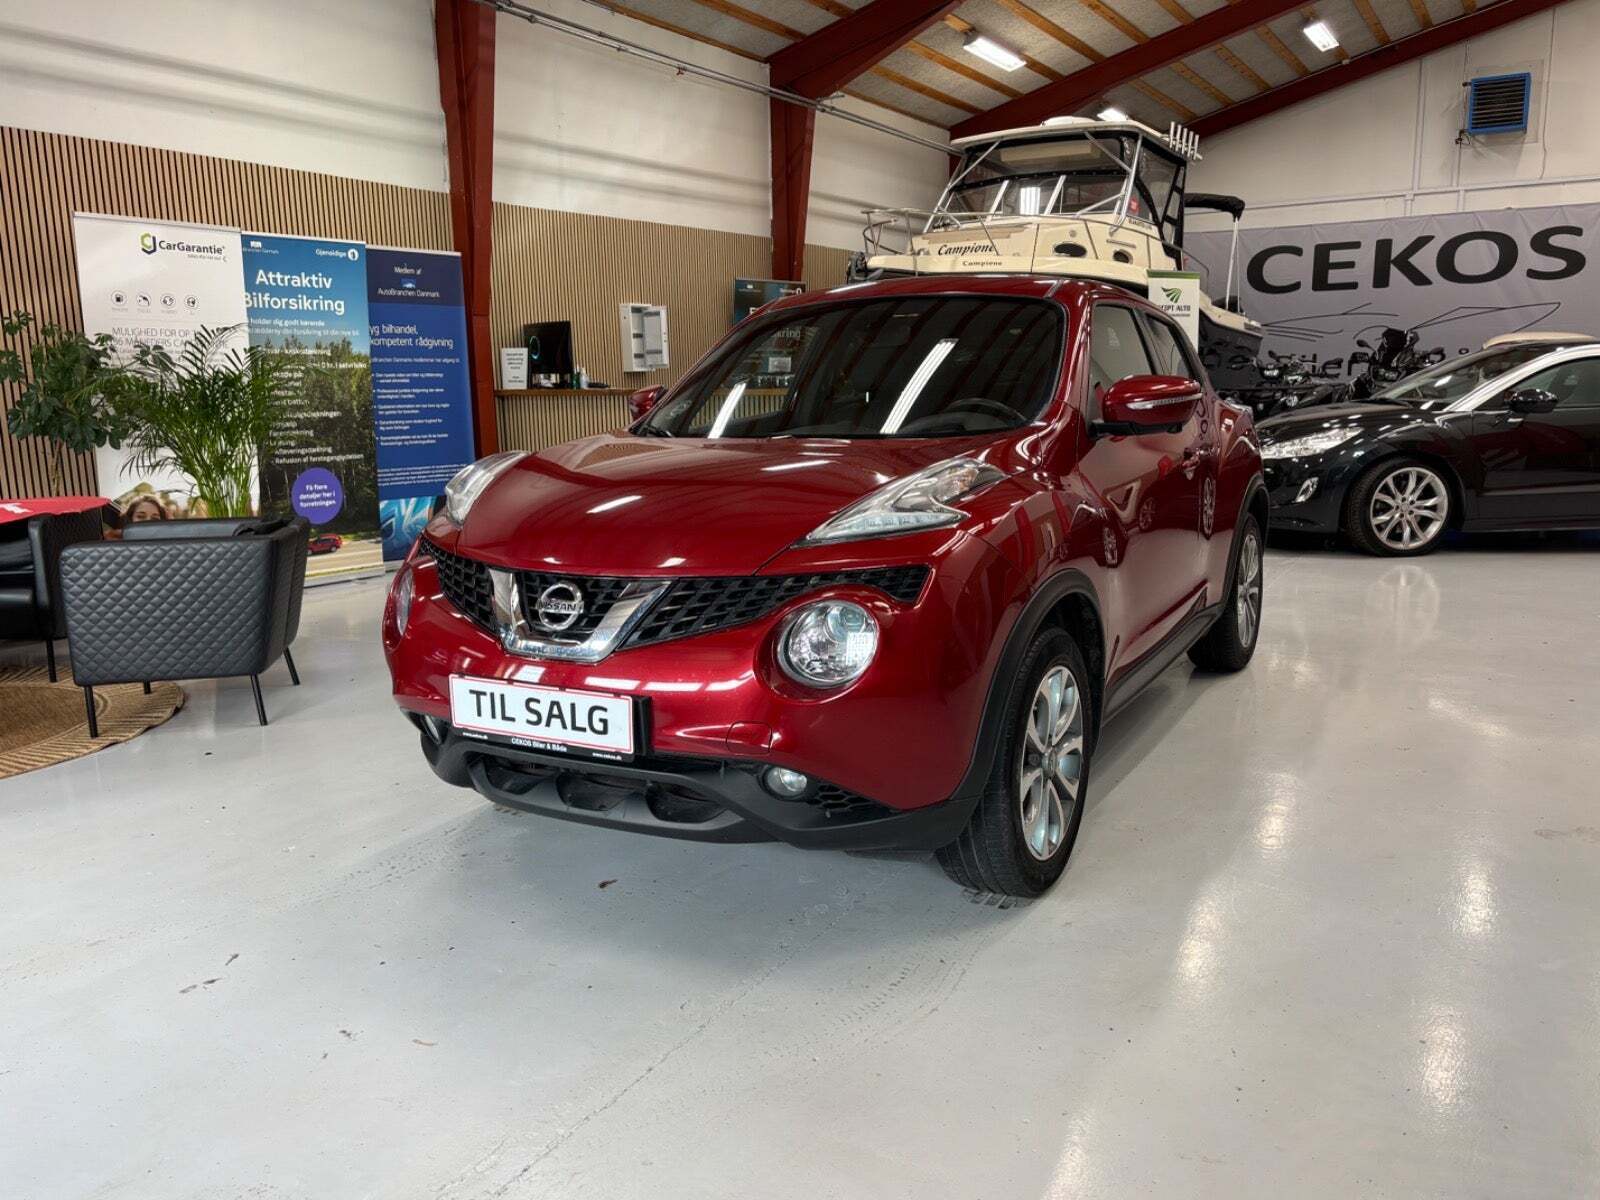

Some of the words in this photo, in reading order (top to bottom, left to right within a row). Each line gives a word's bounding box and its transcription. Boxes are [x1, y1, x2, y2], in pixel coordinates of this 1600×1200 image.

[159, 240, 223, 255] CarGarantie
[938, 242, 996, 257] Campione
[1246, 225, 1587, 294] CEKOS
[255, 269, 333, 288] Attraktiv
[244, 292, 345, 315] Bilforsikring
[112, 327, 158, 337] MULIGHED
[160, 328, 177, 337] FOR
[178, 329, 189, 337] OP
[415, 336, 454, 350] rådgivning
[538, 602, 577, 612] NISSAN
[468, 689, 516, 723] TIL
[524, 696, 609, 736] SALG
[511, 737, 532, 747] CEKOS
